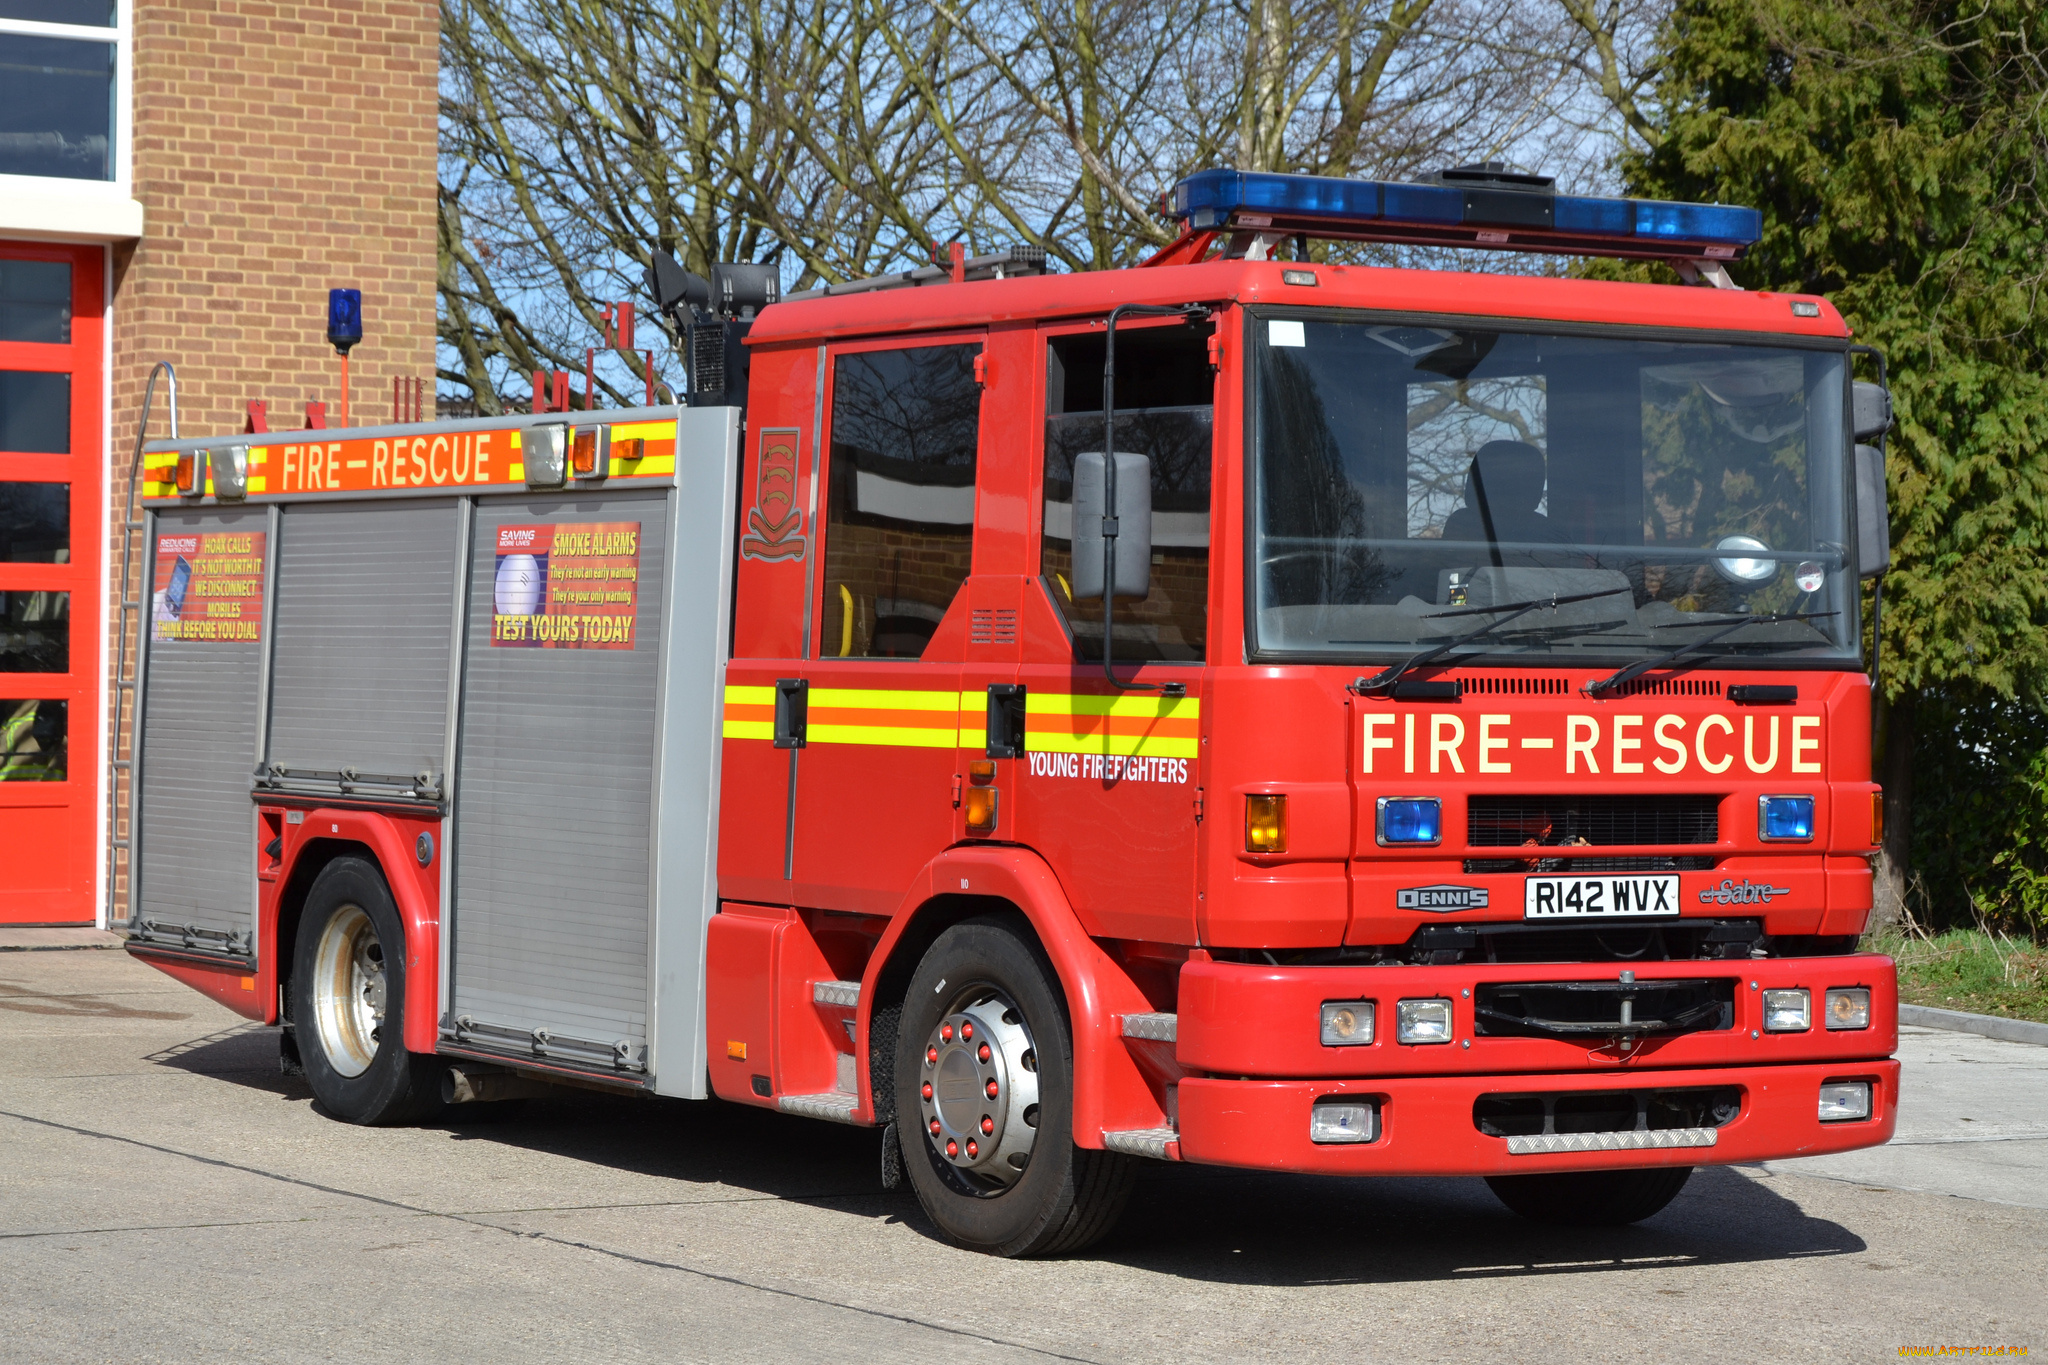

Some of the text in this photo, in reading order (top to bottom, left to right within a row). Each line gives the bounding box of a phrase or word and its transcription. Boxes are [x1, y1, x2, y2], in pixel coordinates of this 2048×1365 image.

[160, 538, 197, 547] REDUCING
[500, 530, 535, 540] SAVING
[553, 532, 637, 556] SMOKE ALARMS
[204, 537, 251, 554] HOAX CALLS
[192, 558, 262, 577] IT'S NOT WORTH IT
[550, 564, 637, 582] They're not an early warning
[195, 580, 257, 597] WE DISCONNECT
[553, 588, 632, 605] They're your only warning
[207, 602, 241, 618] MOBILES
[157, 620, 258, 640] THINK BEFORE YOU DIAL
[495, 615, 633, 642] TEST YOURS TODAY
[1029, 752, 1188, 784] YOUNG FIREFIGHTERS
[1397, 889, 1489, 907] DENNIS
[1536, 880, 1670, 914] R142 WVX
[1717, 879, 1773, 905] Sabre
